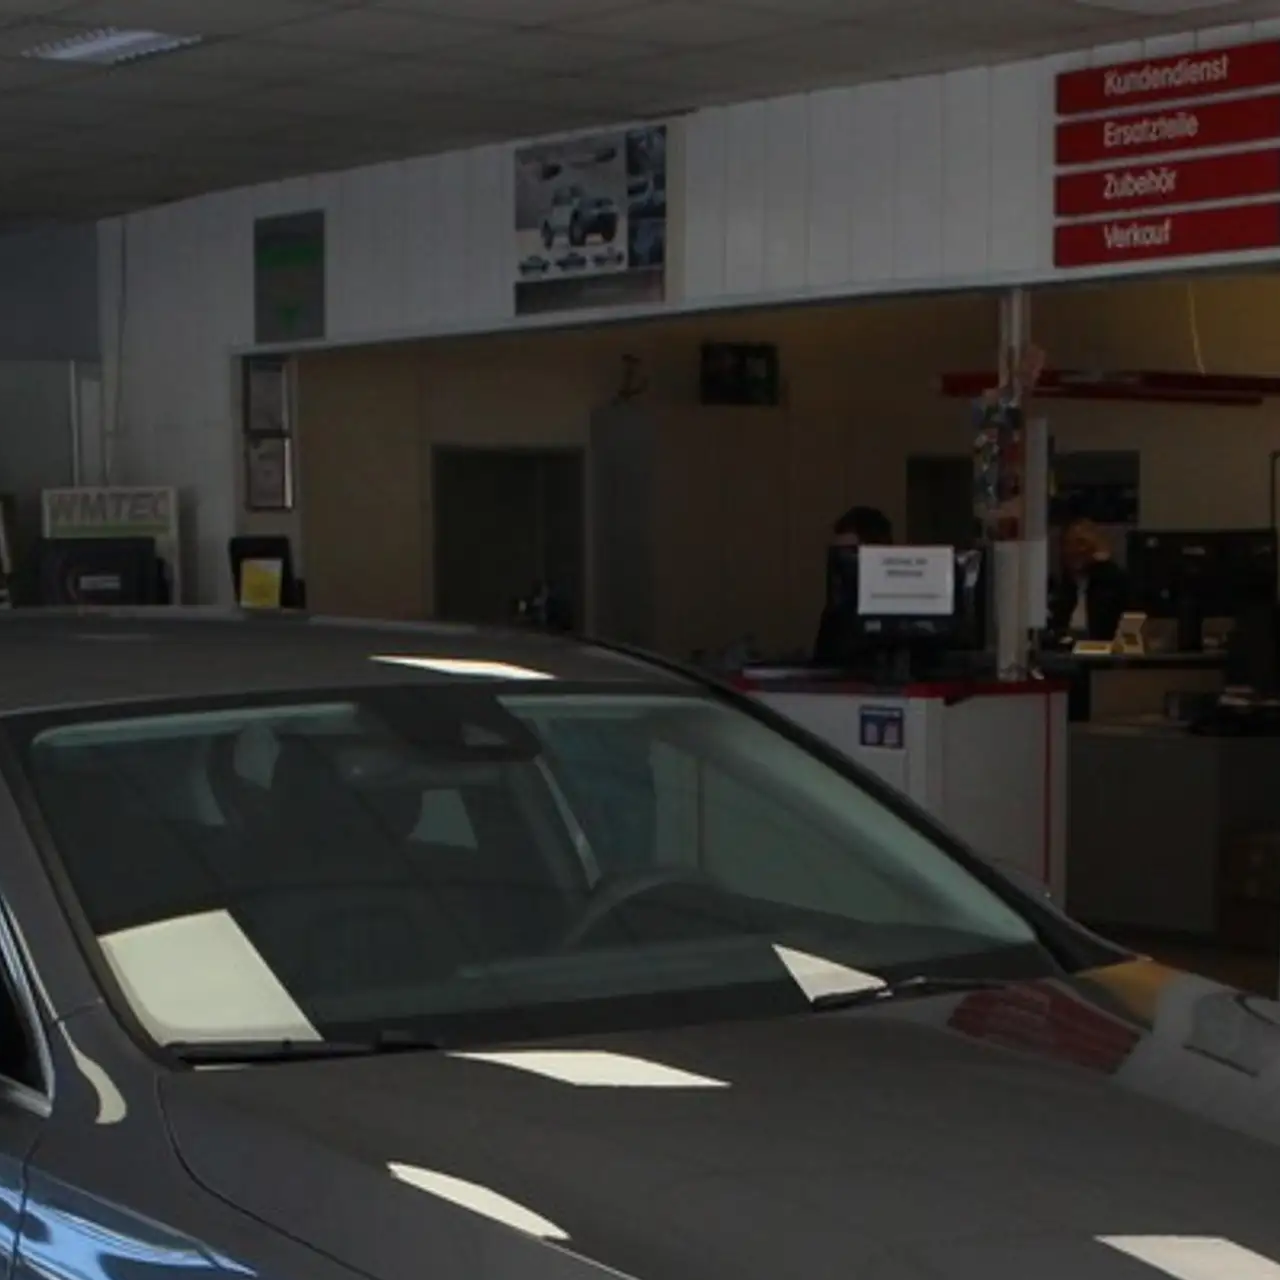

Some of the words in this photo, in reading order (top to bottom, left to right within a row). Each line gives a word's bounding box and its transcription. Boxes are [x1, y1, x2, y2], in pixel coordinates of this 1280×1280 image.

[1104, 53, 1229, 95] Kundendienst
[1103, 113, 1199, 148] Ersatzteile
[1103, 167, 1177, 199] Zubehör
[1104, 217, 1172, 249] Verkauf
